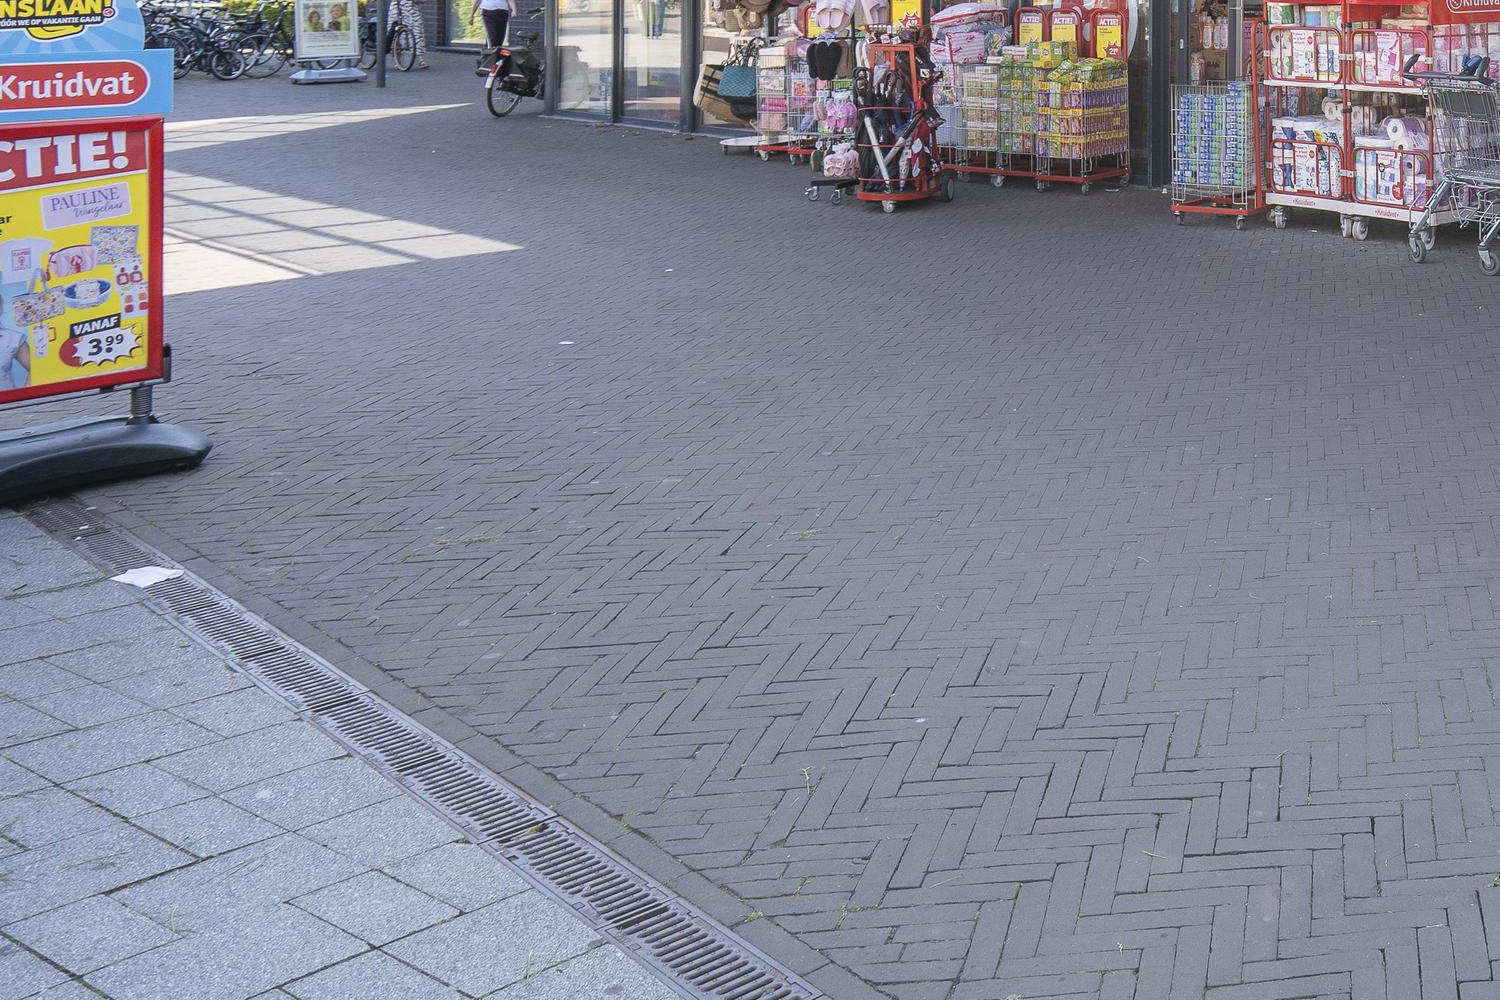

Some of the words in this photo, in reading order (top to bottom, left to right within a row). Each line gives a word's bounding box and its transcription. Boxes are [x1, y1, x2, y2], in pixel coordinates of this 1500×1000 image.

[0, 18, 17, 28] ÓÓR
[42, 17, 79, 25] VAKANTIE
[0, 71, 134, 100] Kruidvat
[50, 187, 120, 212] PAULINE
[72, 316, 118, 336] VANAF
